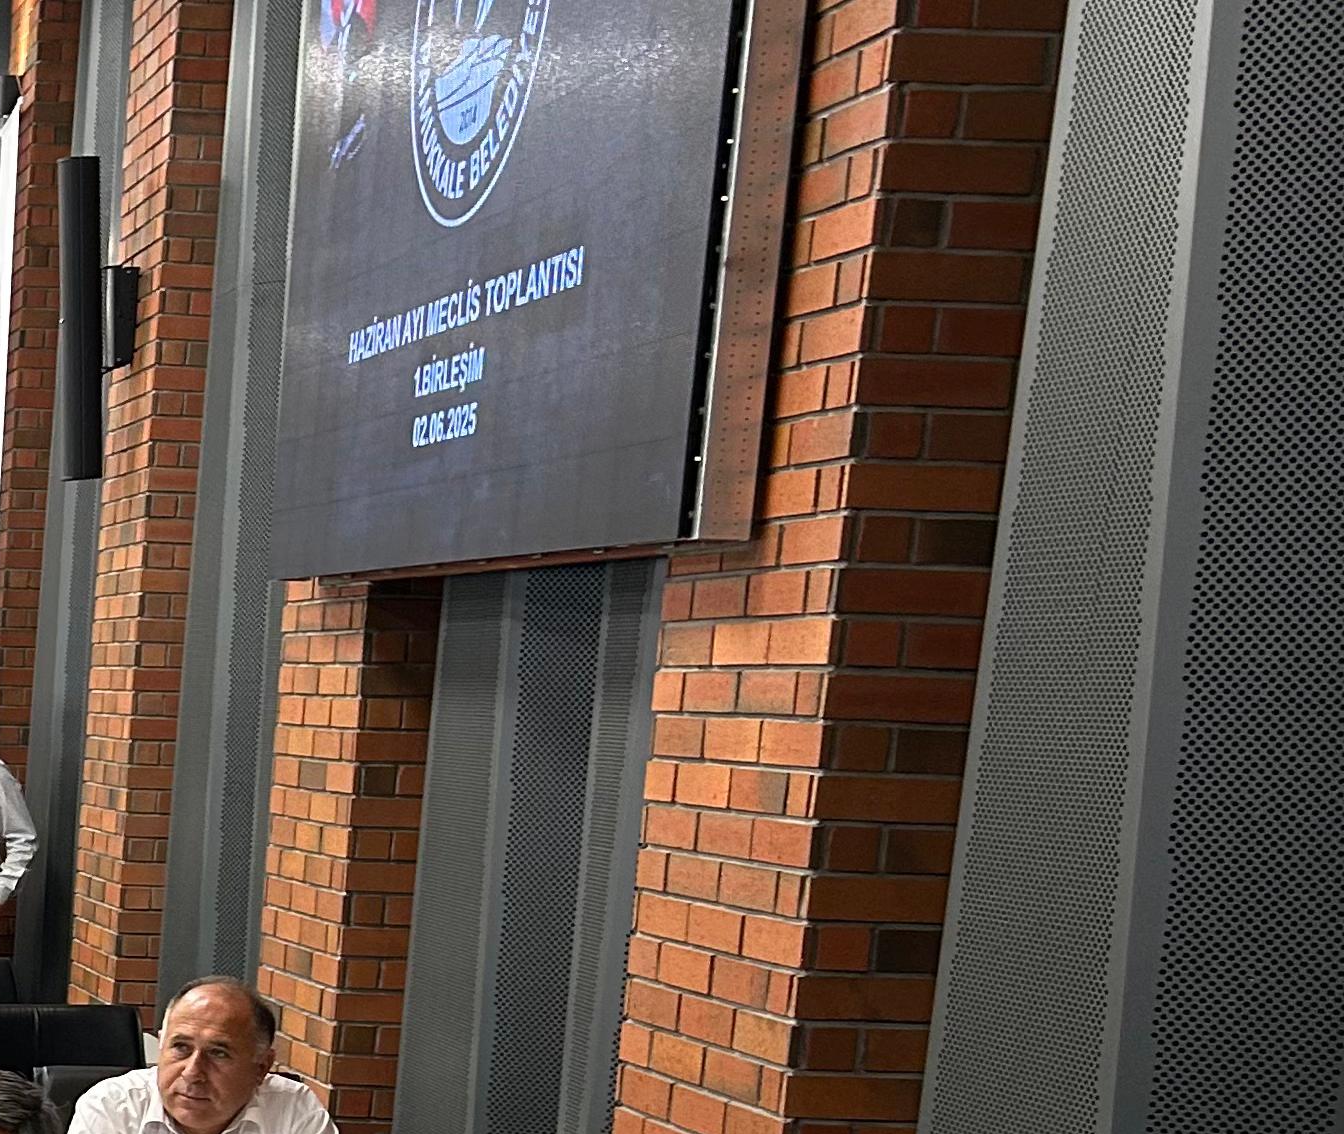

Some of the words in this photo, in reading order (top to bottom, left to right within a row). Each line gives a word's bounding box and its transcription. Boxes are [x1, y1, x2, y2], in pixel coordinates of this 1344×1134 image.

[469, 0, 542, 190] BELEDİYE
[348, 316, 402, 364] HAZİRAN
[401, 305, 425, 346] AYI
[425, 279, 481, 337] MECLİS
[485, 245, 585, 316] TOPLANTISI
[412, 402, 478, 447] 02.06.2025
